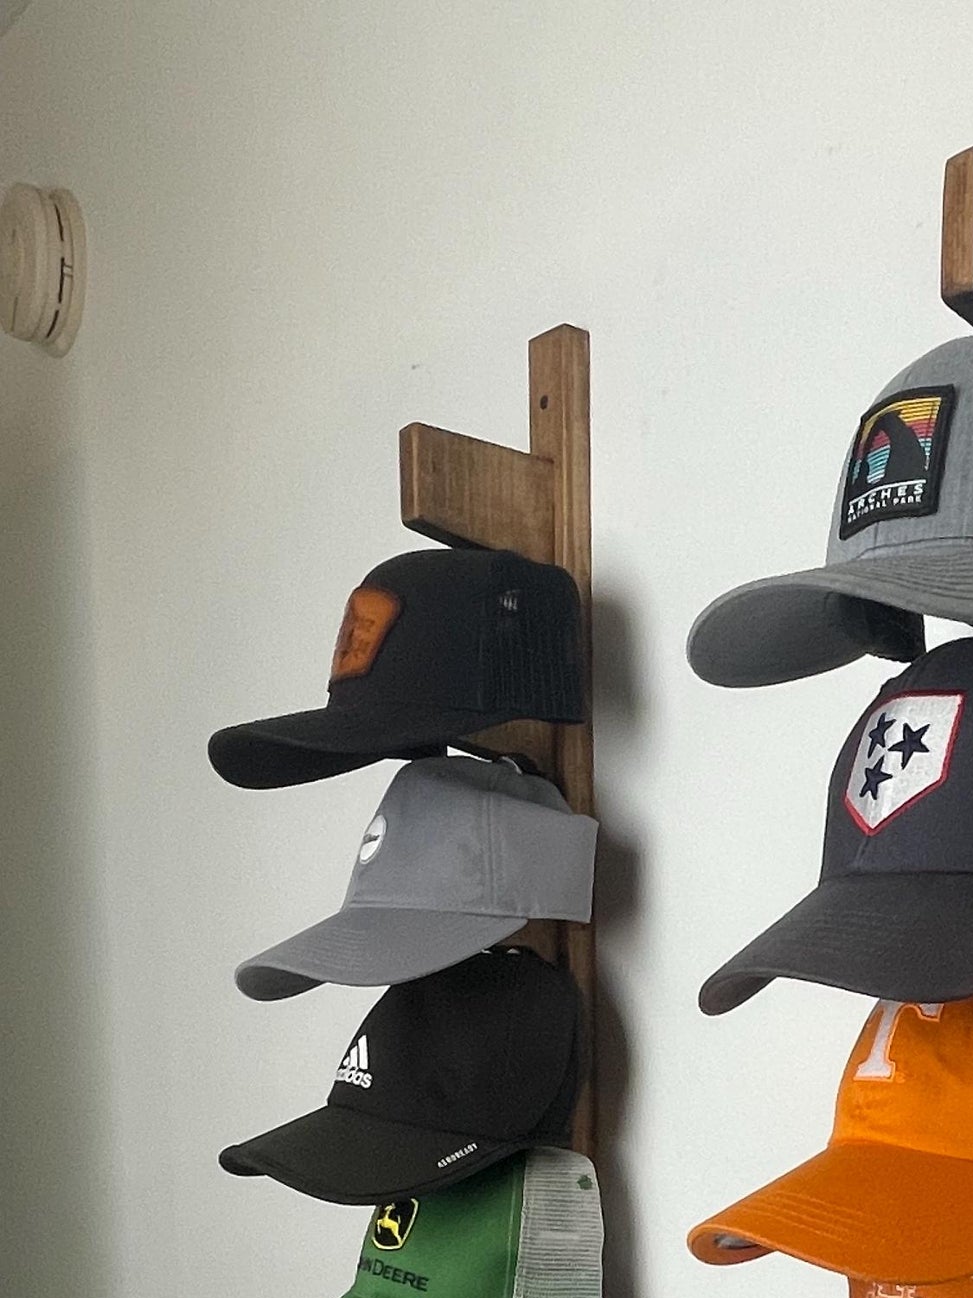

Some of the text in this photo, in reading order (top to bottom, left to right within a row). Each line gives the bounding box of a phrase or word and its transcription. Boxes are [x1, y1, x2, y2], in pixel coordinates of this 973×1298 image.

[847, 483, 924, 515] ARCHES
[847, 494, 923, 523] NATIONAL PARK
[371, 1258, 430, 1293] DEERE
